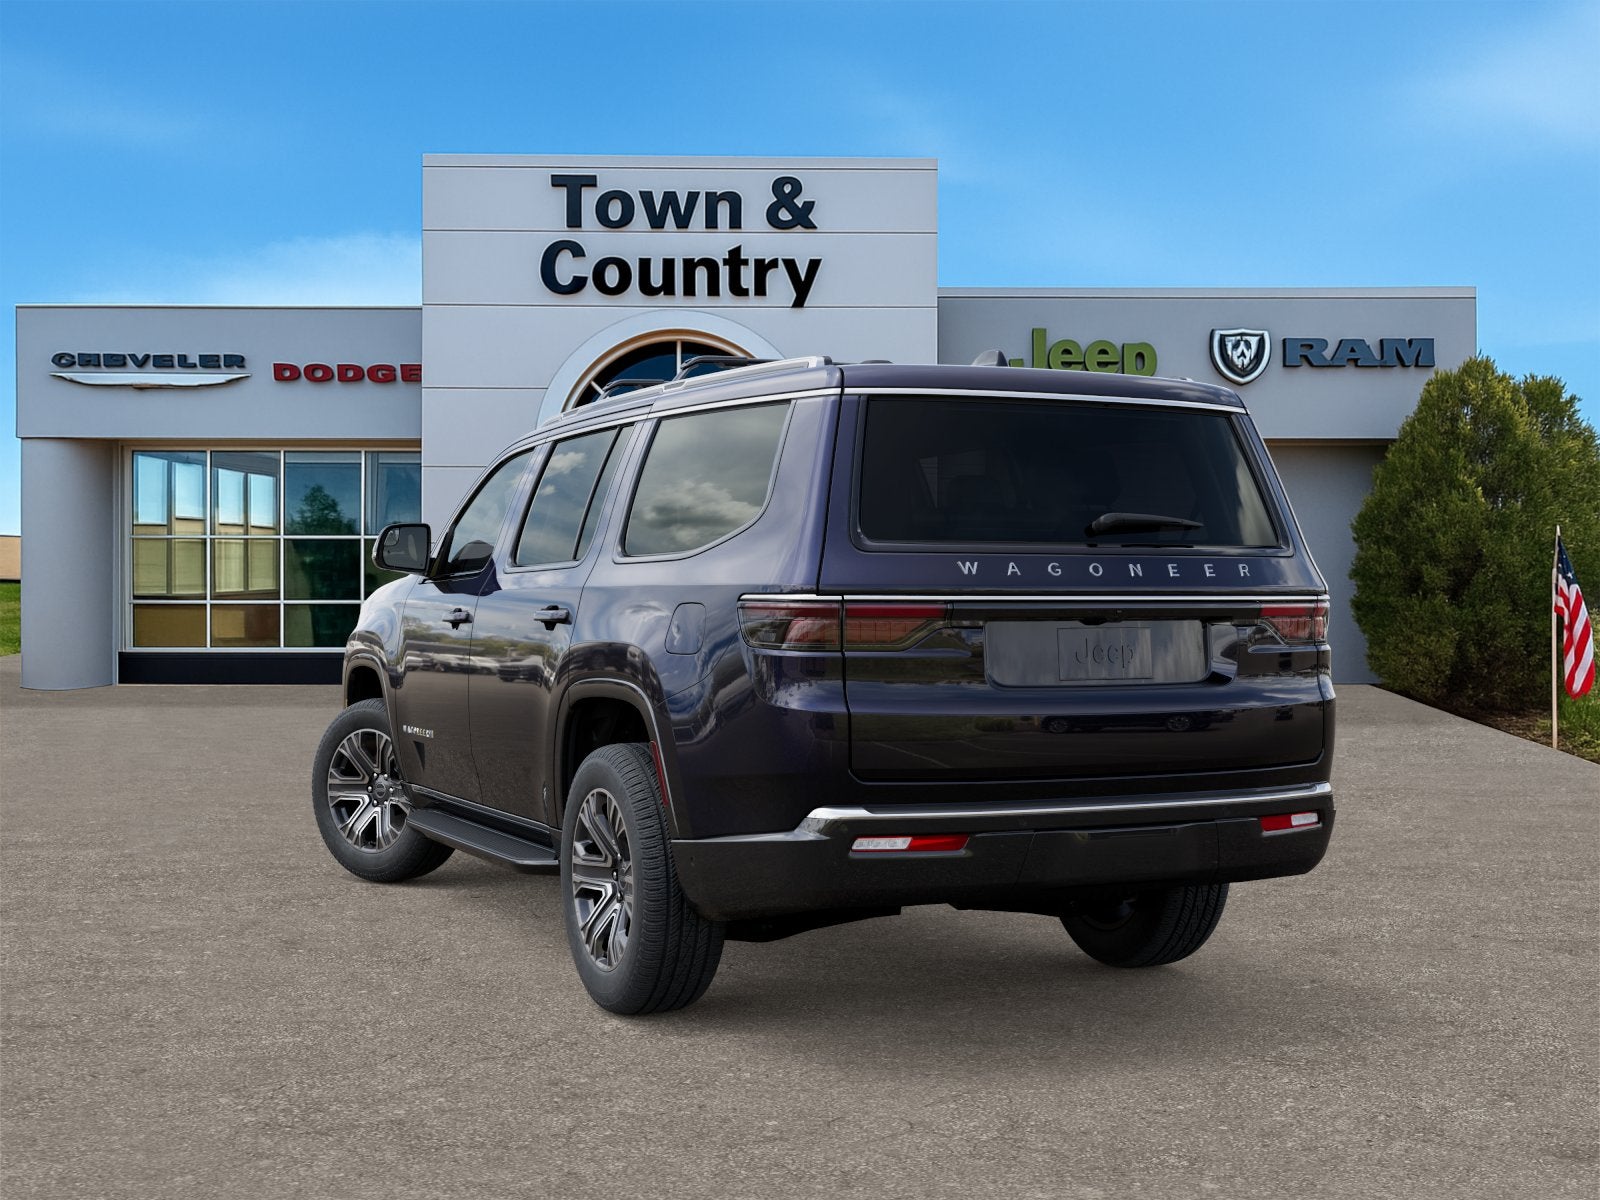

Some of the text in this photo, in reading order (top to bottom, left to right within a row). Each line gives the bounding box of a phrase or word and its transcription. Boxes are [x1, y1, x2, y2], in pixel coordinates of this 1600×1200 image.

[550, 174, 818, 230] Town &
[540, 239, 823, 308] Country
[1008, 328, 1158, 377] Jeep
[1282, 338, 1436, 367] RAM
[273, 363, 422, 383] DODGE
[956, 561, 1251, 578] WAGONEER
[1074, 637, 1134, 669] Jeep
